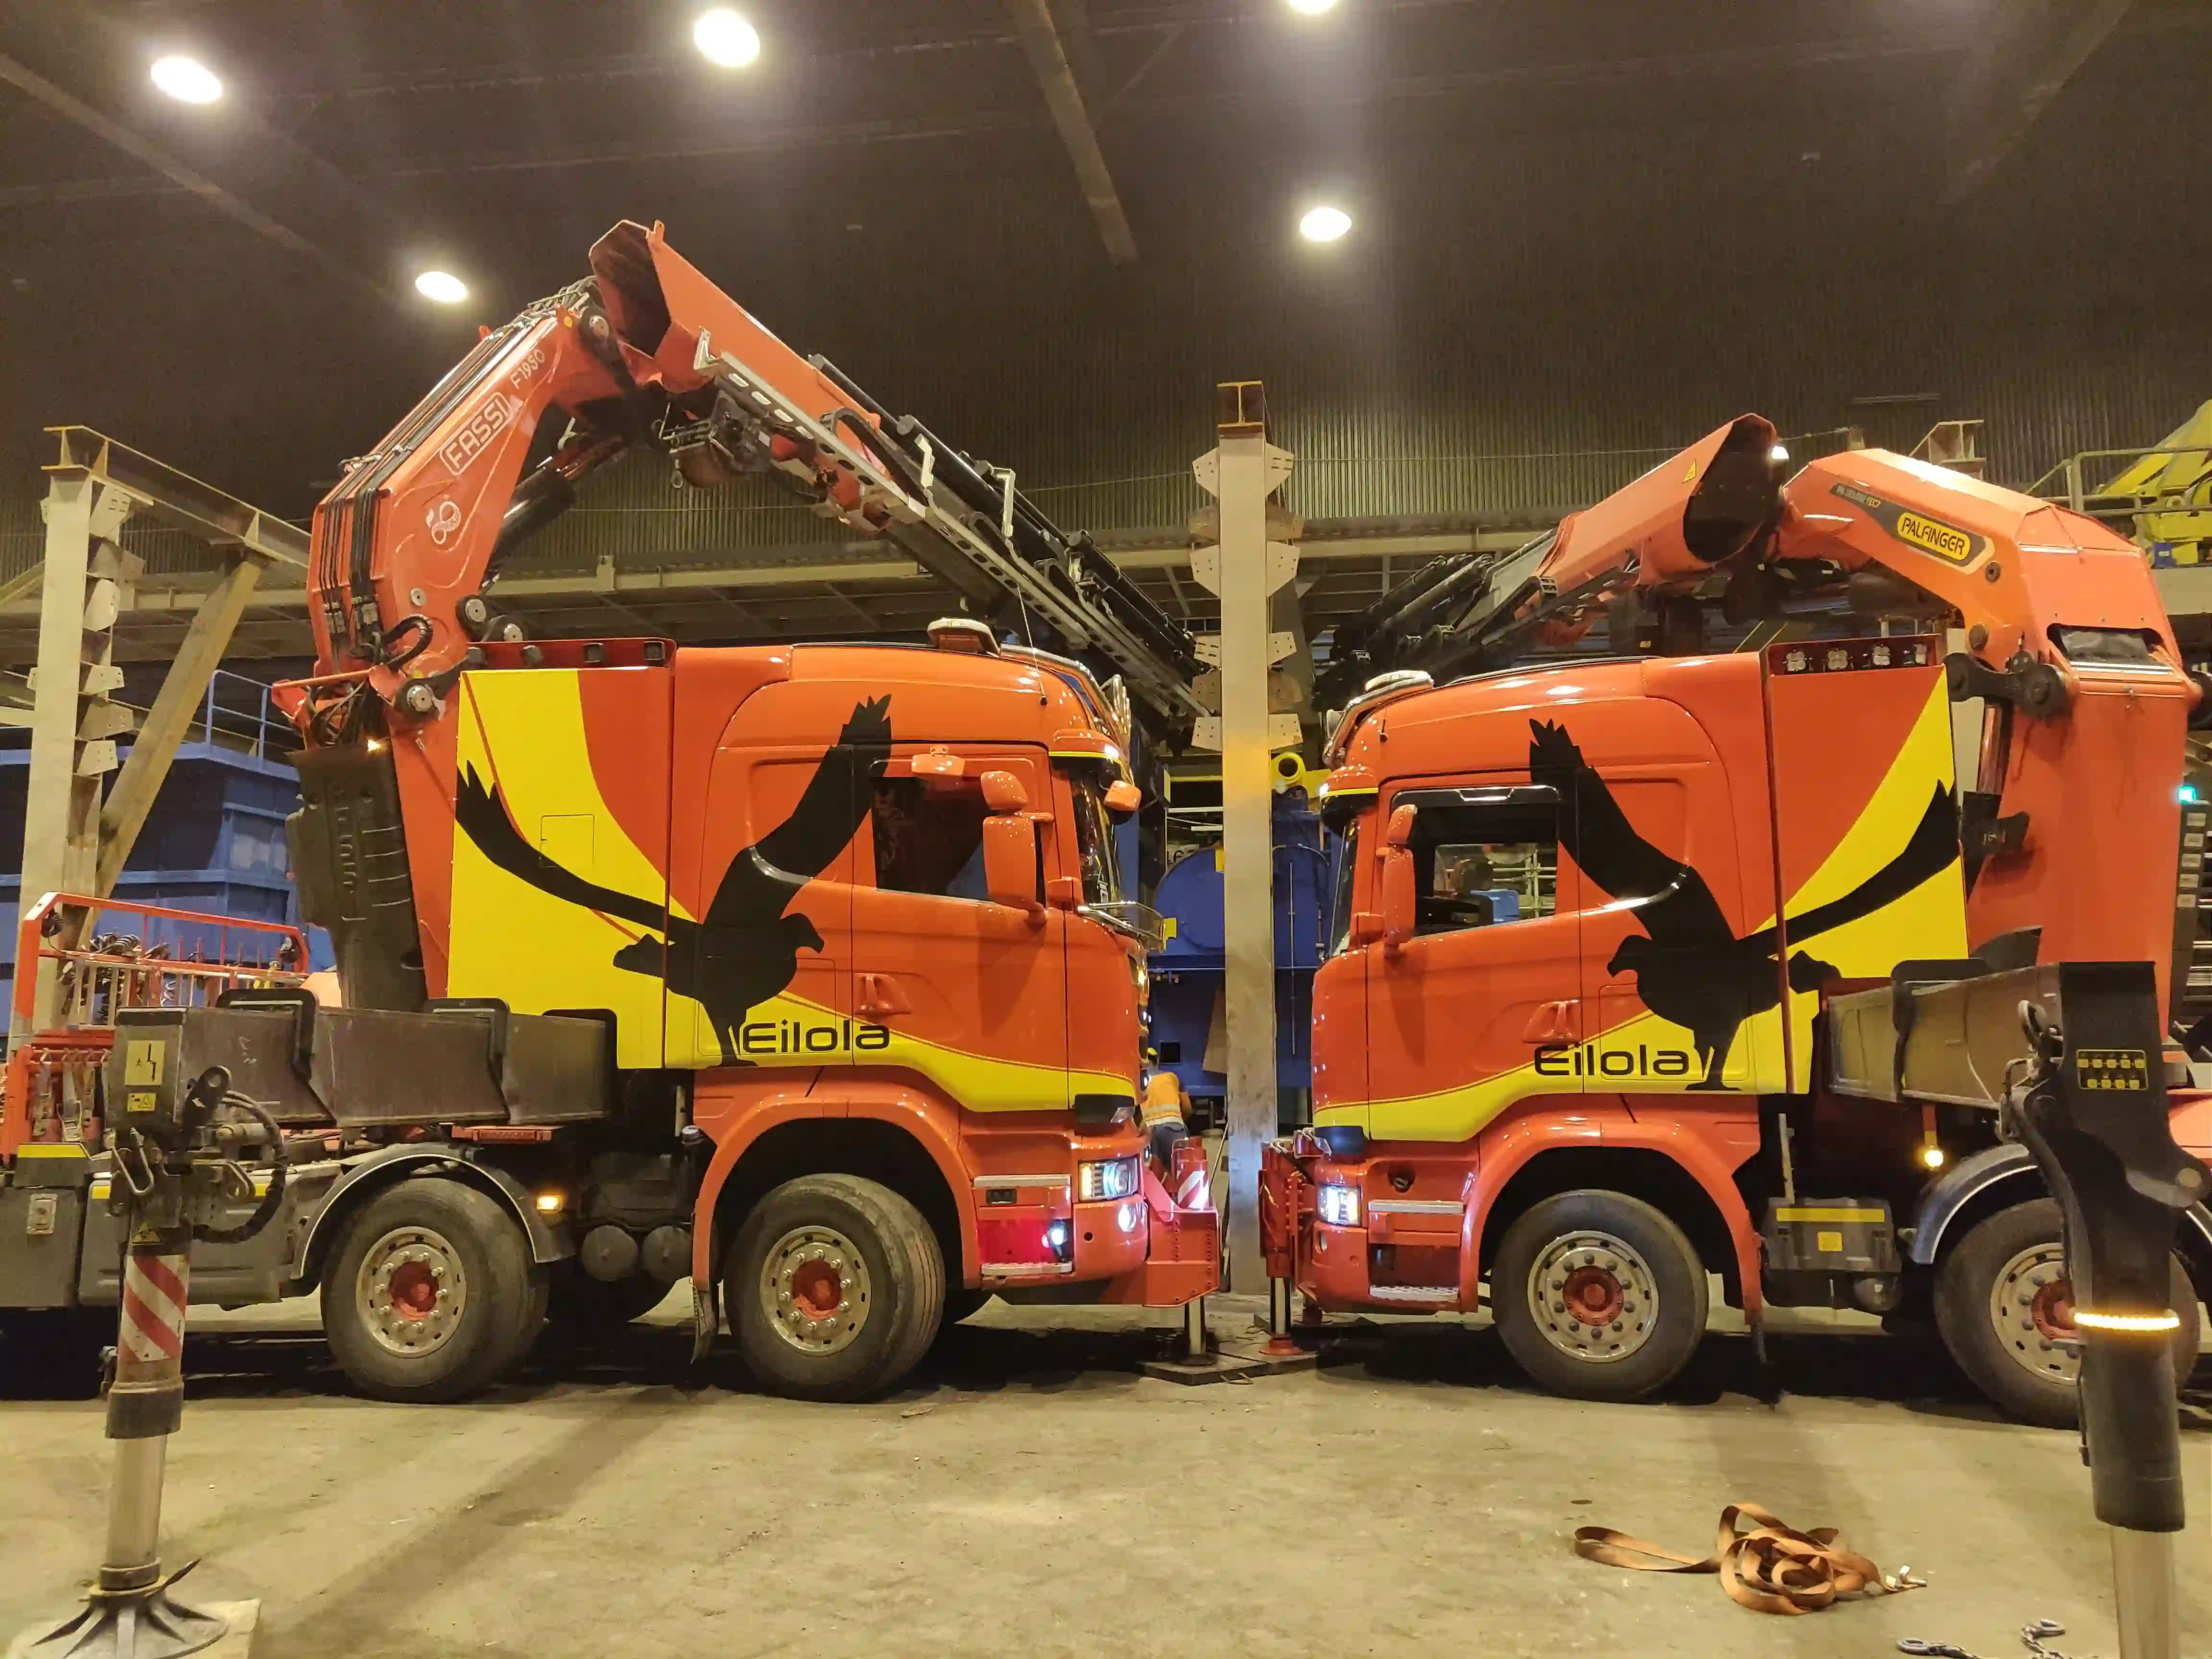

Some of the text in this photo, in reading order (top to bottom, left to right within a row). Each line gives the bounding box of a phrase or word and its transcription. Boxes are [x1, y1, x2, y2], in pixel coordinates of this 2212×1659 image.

[510, 349, 546, 390] F1950
[445, 398, 510, 469] FASSI
[1901, 517, 1965, 555] PALFINGER
[743, 1019, 890, 1053] Eilola
[1535, 1042, 1689, 1076] Eilola
